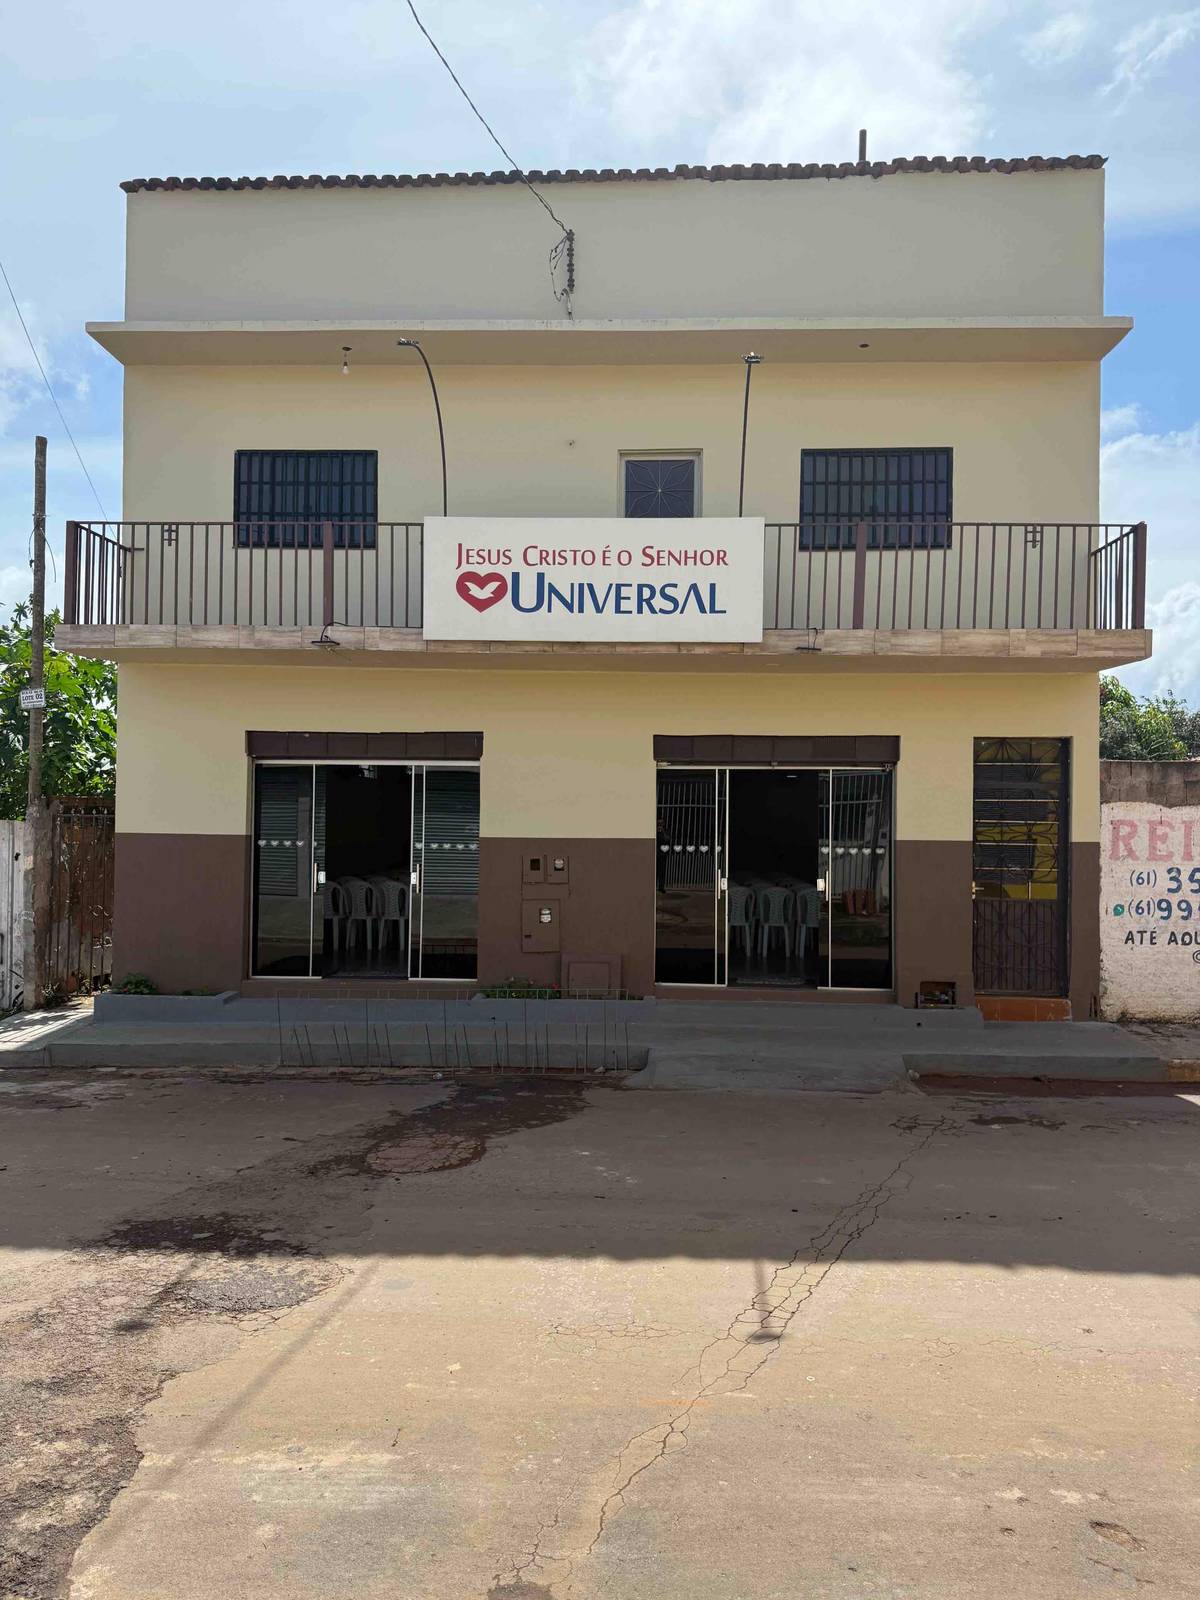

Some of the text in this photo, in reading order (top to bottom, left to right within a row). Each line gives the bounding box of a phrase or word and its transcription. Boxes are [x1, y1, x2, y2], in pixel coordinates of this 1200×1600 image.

[455, 543, 729, 570] JESUS CRISTO É O SENHOR
[511, 571, 727, 615] UNIVERSAL
[1129, 869, 1157, 888] (61)
[1124, 927, 1157, 946] ATÉ
